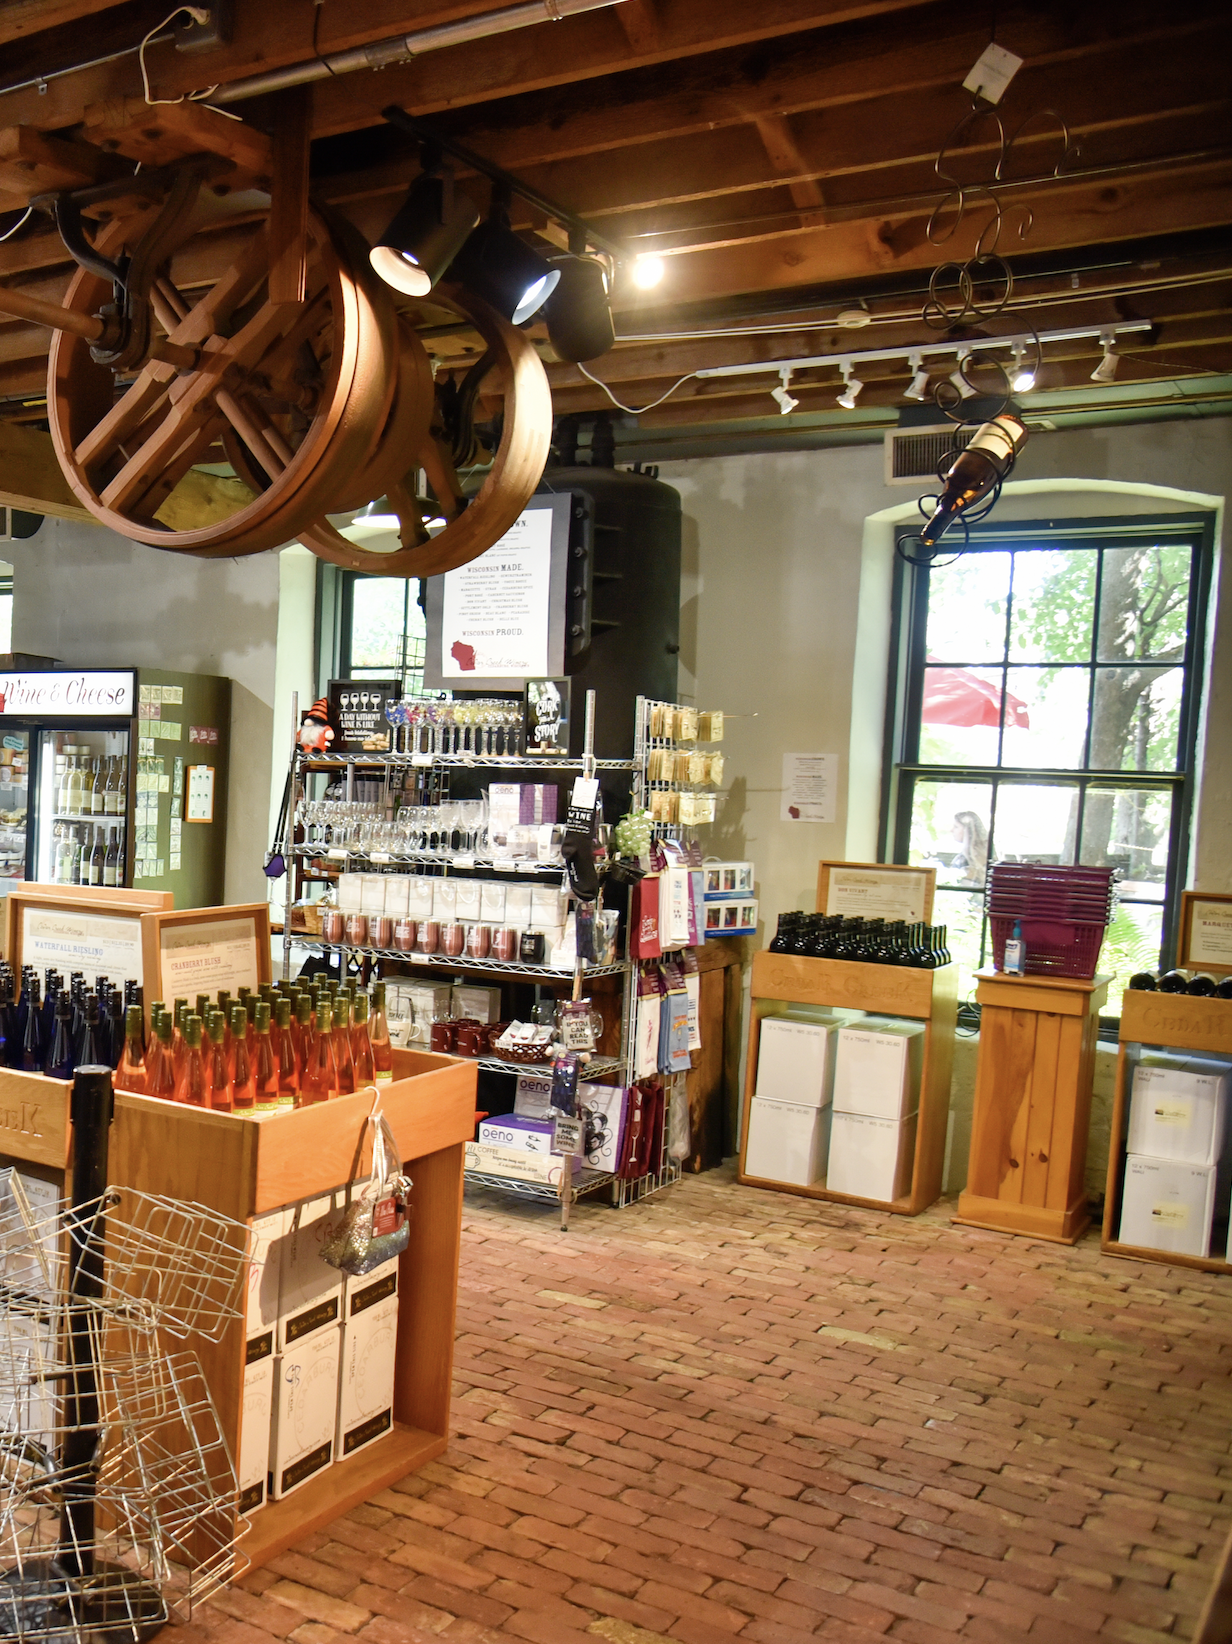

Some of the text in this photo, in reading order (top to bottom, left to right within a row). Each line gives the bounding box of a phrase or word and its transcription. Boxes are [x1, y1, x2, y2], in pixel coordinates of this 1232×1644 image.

[501, 563, 524, 571] MADE.
[495, 628, 524, 636] PROUD.
[3, 679, 47, 705] Wine
[66, 677, 125, 705] Cheese
[536, 700, 559, 720] CORK
[344, 713, 356, 721] DAY
[356, 713, 381, 721] WITHOUT
[340, 720, 355, 729] WINE
[534, 722, 561, 743] STORY
[568, 812, 592, 821] WINE
[1202, 920, 1232, 928] MARQUET
[34, 941, 104, 956] WATERFALL RIESLING
[171, 956, 221, 971] CRANBERRY BLUSH
[520, 1079, 551, 1092] oeno
[557, 1122, 579, 1132] BRING
[482, 1128, 514, 1142] oeno
[556, 1139, 575, 1149] WINE
[477, 1146, 499, 1155] COFFEE
